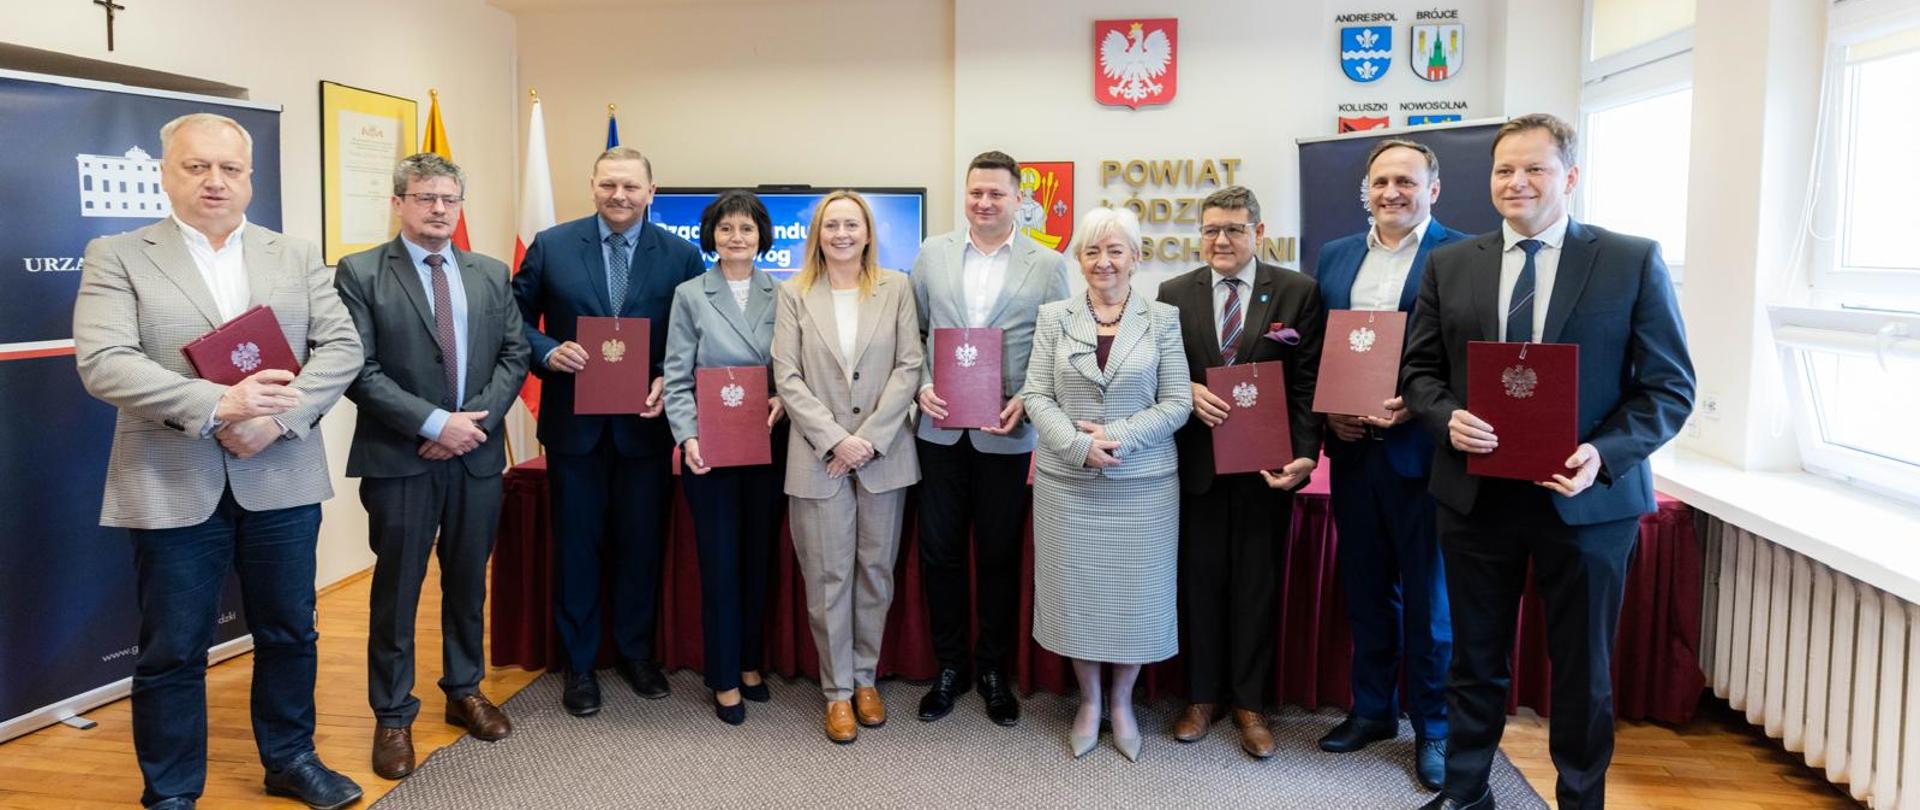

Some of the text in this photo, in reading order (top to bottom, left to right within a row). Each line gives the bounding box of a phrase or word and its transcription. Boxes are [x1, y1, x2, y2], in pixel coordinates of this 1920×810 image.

[1335, 13, 1398, 22] ANDRESPOL
[1416, 8, 1458, 20] BRÓJCE
[1339, 103, 1388, 112] KOLUSZKI
[1400, 101, 1468, 111] NOWOSOLNA
[1101, 158, 1242, 188] POWIAT
[23, 257, 84, 272] URZA
